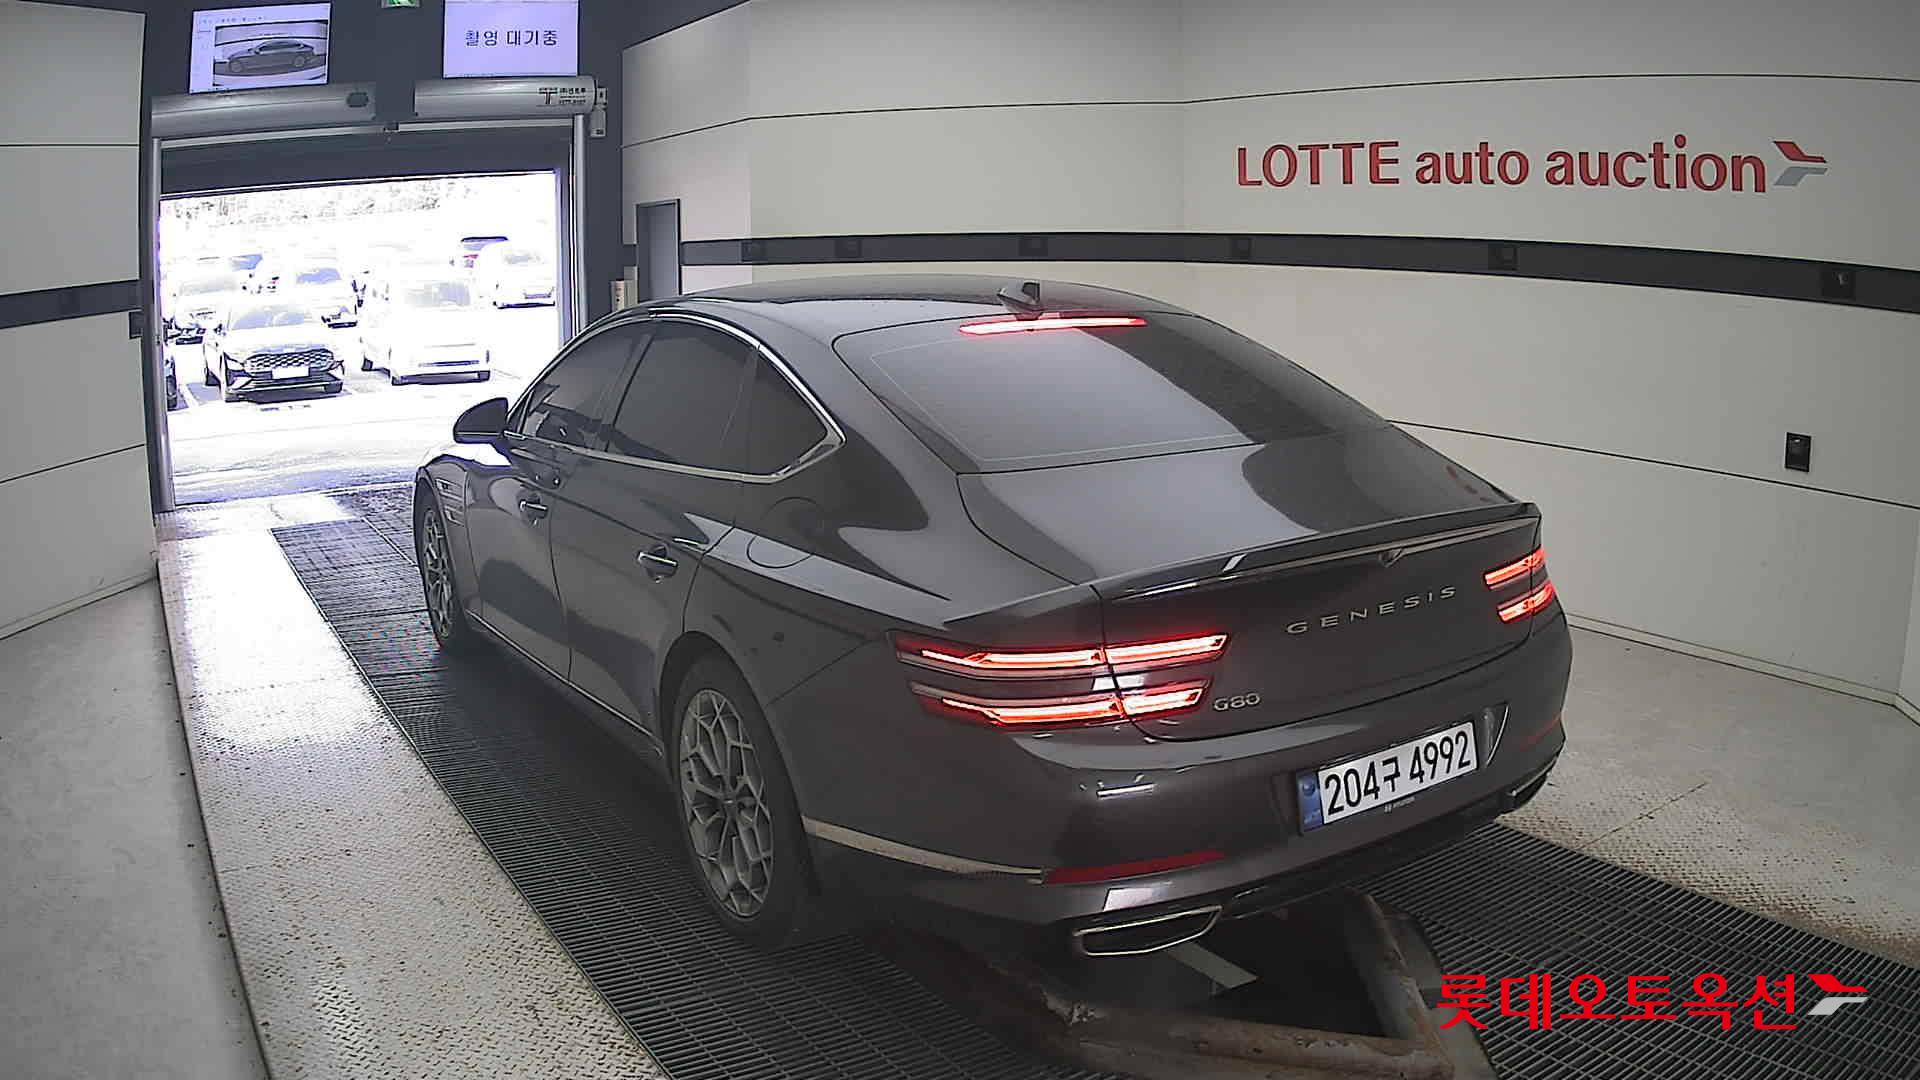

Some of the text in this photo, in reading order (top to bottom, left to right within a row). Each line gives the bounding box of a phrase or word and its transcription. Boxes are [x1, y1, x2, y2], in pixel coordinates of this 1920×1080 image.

[465, 30, 557, 46] 촬영 대기중
[1237, 134, 1767, 193] LOTTE auto auction
[1286, 586, 1456, 634] GENESIS
[1213, 692, 1260, 711] G80
[1324, 731, 1471, 815] 204구 4992
